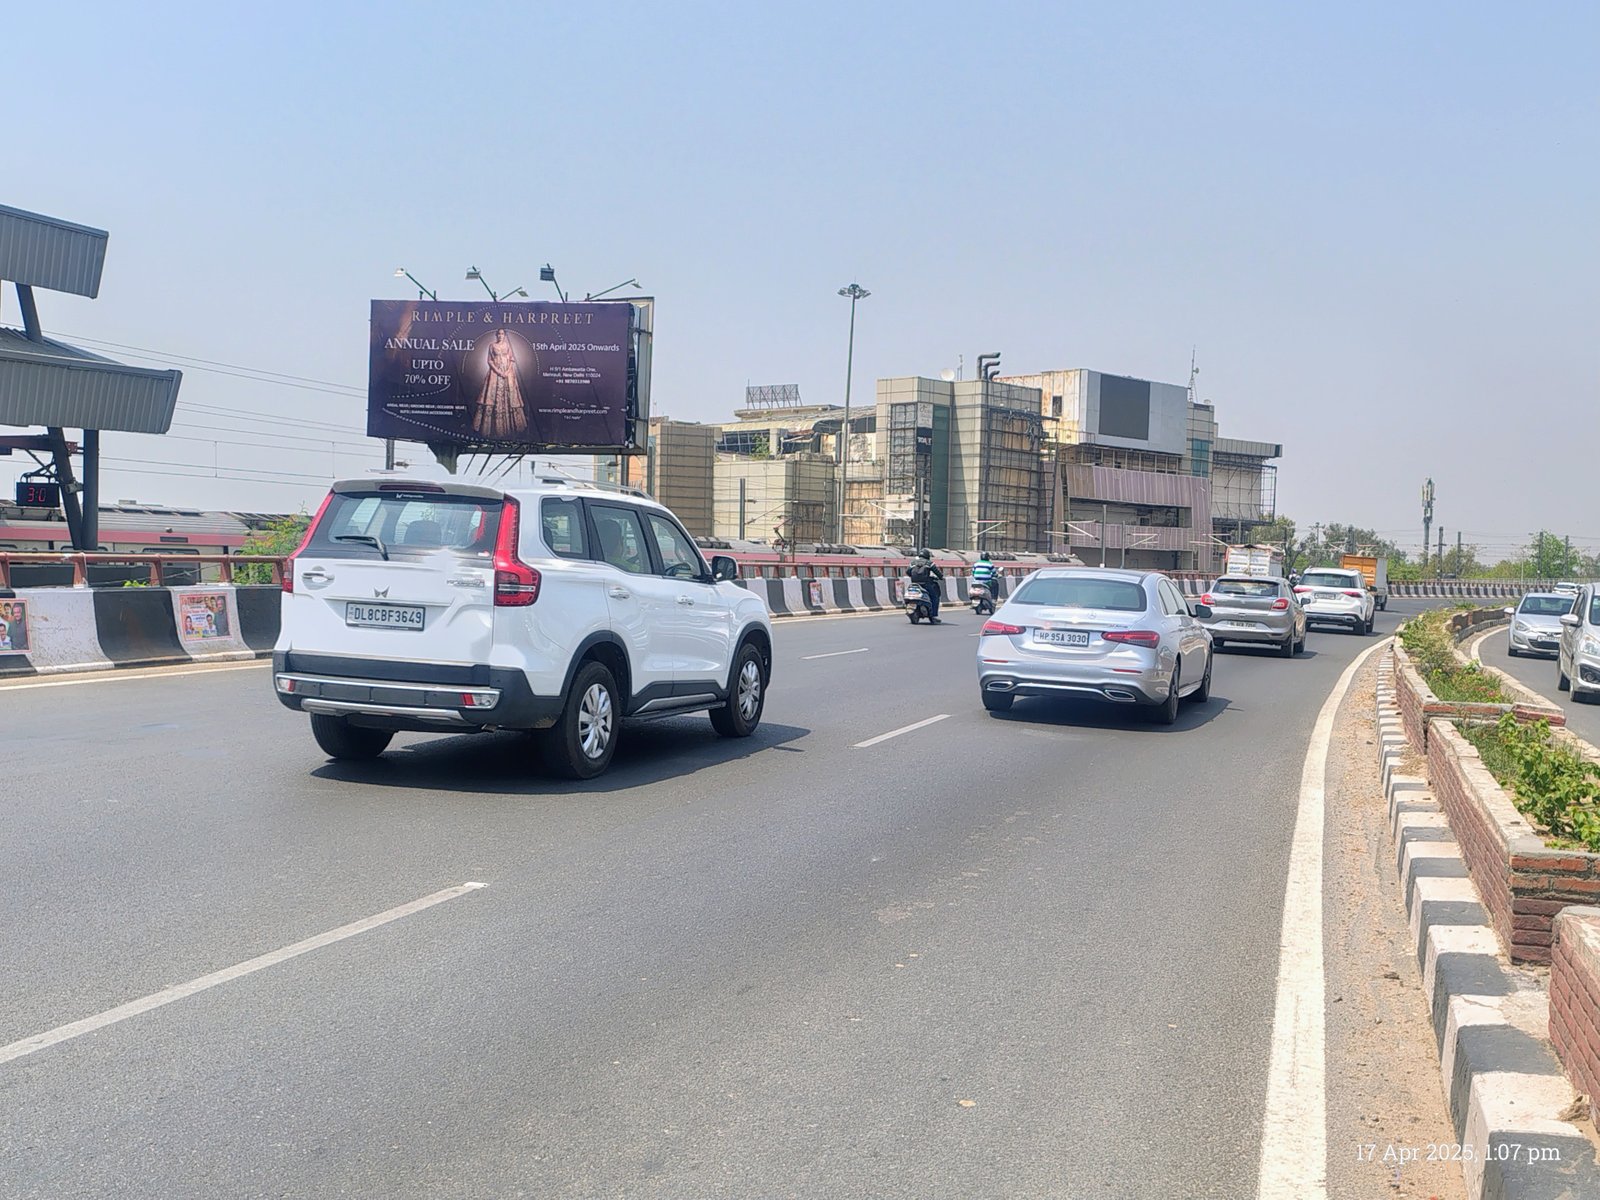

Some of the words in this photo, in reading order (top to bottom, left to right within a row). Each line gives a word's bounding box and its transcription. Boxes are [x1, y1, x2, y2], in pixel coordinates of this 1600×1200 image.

[412, 311, 475, 323] RIMPLE
[483, 312, 493, 323] &
[503, 312, 594, 324] HARPREET
[384, 338, 440, 350] ANNUAL
[441, 339, 475, 351] SALE
[532, 343, 548, 351] 15th
[549, 343, 567, 352] April
[568, 343, 586, 351] 2025
[587, 343, 620, 352] Onwards
[412, 359, 444, 370] UPTO
[404, 374, 426, 384] 70%
[428, 375, 452, 385] OFF
[354, 607, 422, 624] DL8CBF3649
[1067, 634, 1087, 643] 3030
